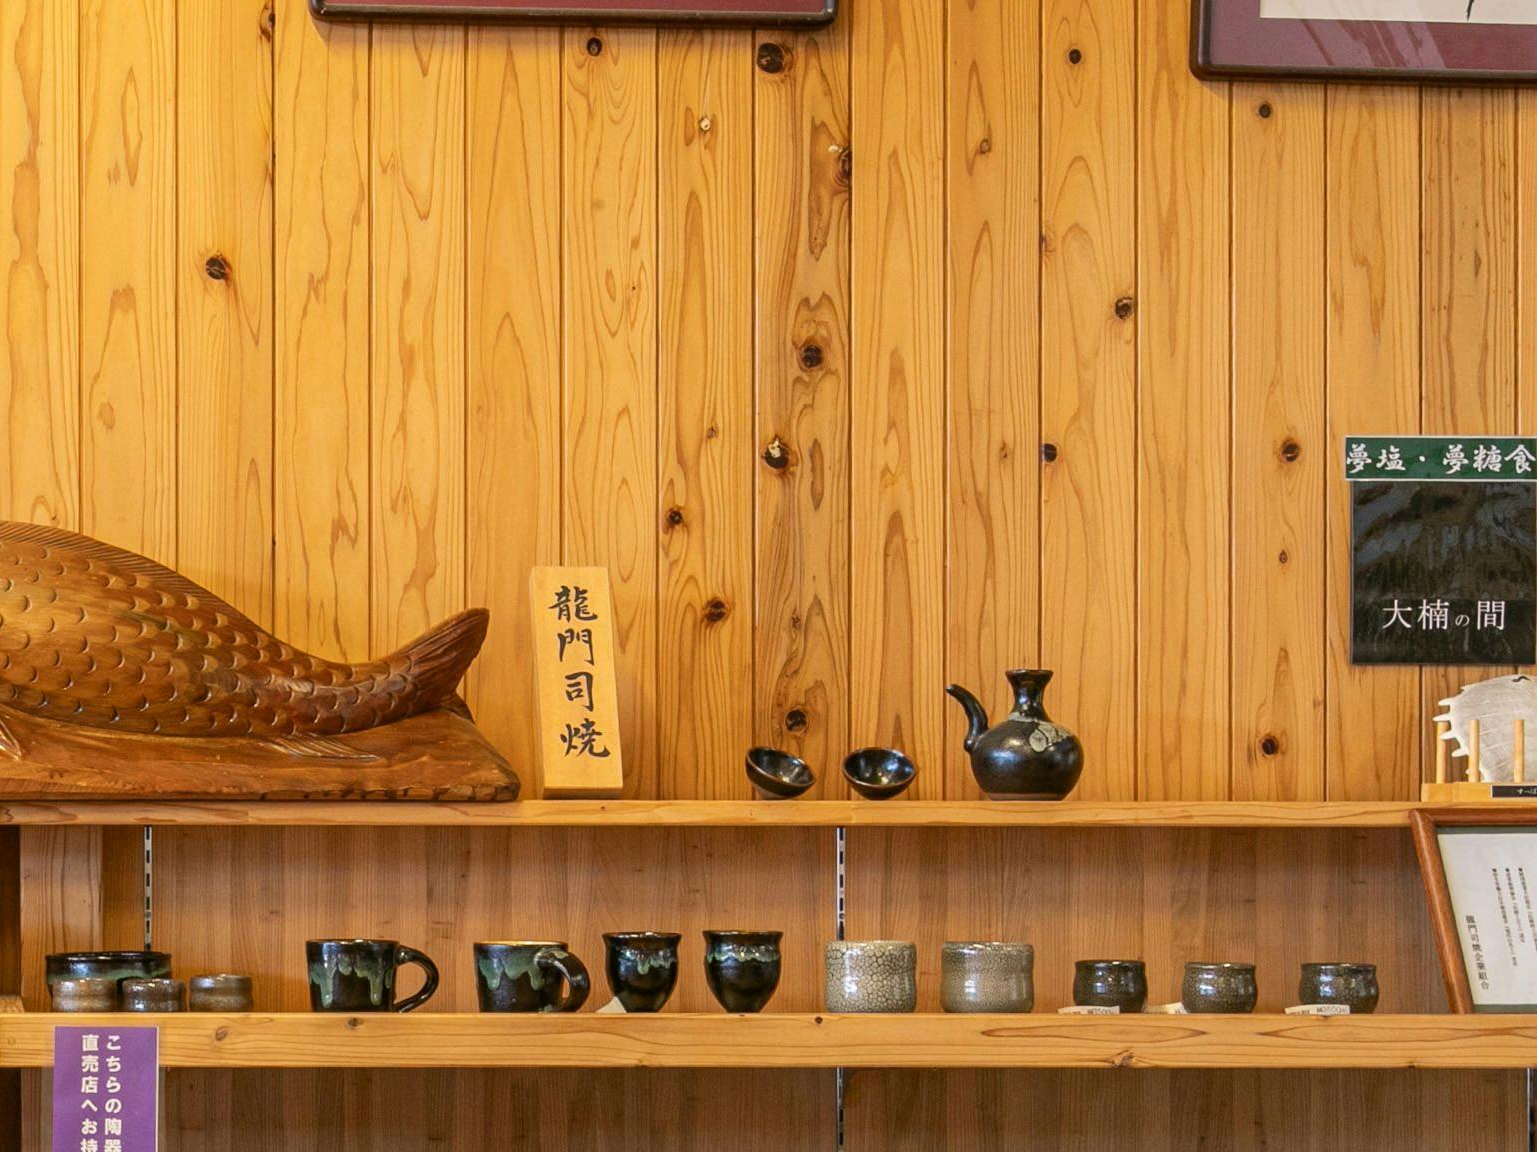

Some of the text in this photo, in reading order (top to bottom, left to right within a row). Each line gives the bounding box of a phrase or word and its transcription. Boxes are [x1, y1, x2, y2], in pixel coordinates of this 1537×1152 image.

[1382, 598, 1506, 631] 大楠の間
[548, 585, 611, 758] 龍門司焼
